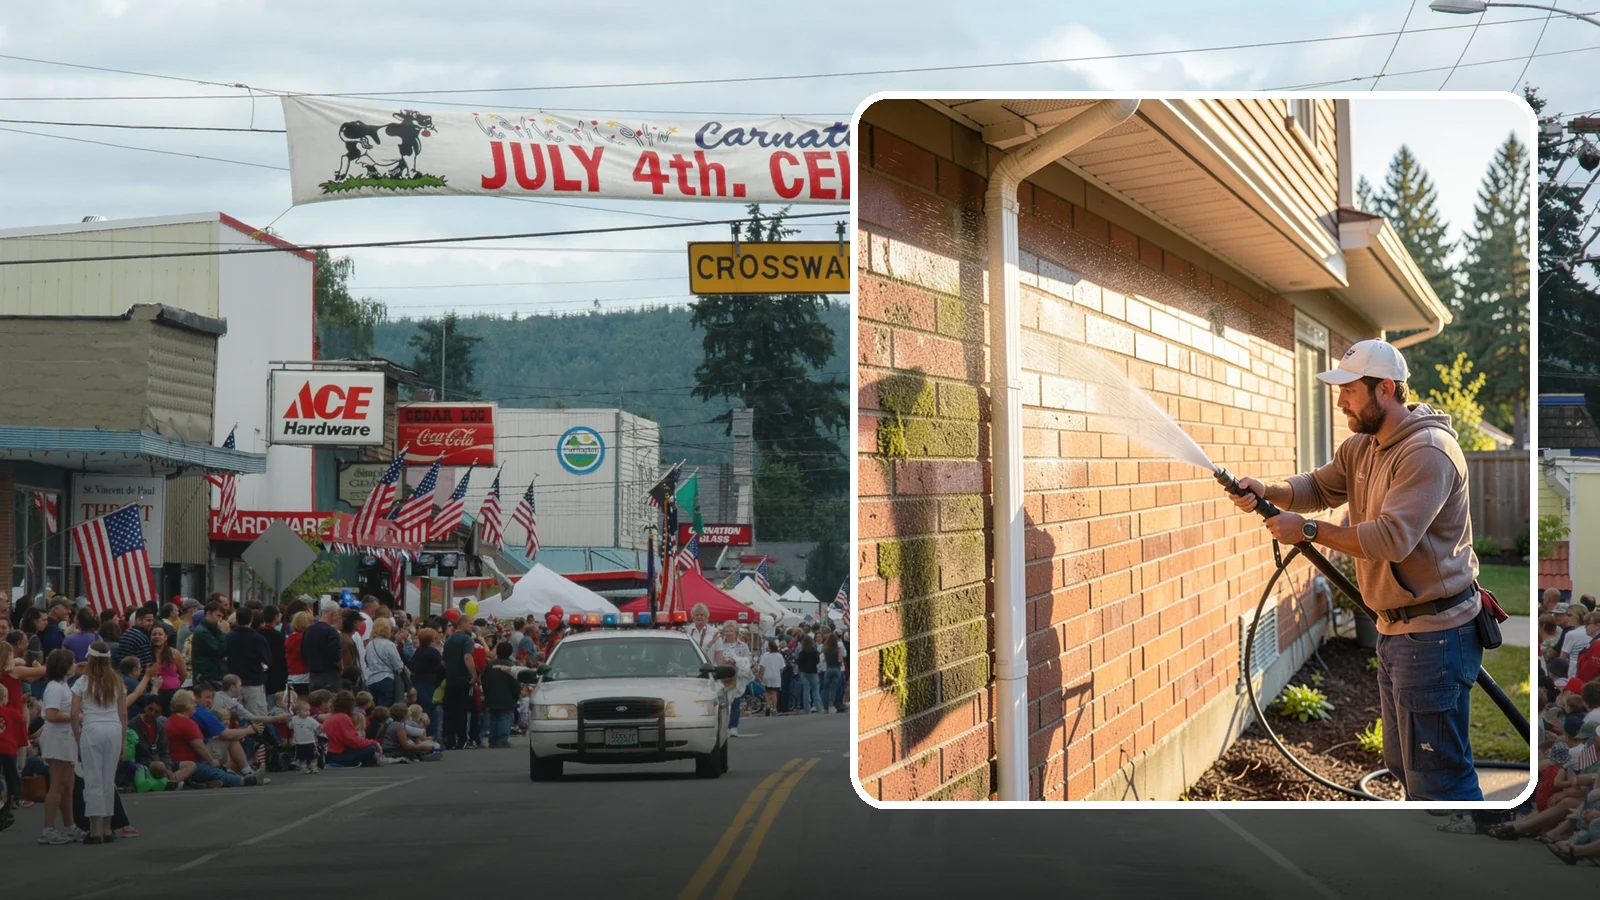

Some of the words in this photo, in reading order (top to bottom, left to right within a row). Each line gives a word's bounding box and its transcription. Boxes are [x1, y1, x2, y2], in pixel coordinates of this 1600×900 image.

[481, 141, 604, 193] JULY
[632, 150, 746, 198] 4th.
[696, 254, 850, 280] CROSSWA
[283, 380, 373, 420] ACE
[405, 409, 452, 422] CEDAR
[283, 421, 370, 436] Hardware
[353, 467, 386, 479] Simpl
[96, 484, 124, 495] Vincent
[126, 485, 136, 495] de
[138, 486, 155, 495] Paul
[80, 503, 154, 522] THT
[688, 526, 741, 535] CRNATION
[699, 535, 730, 543] GLASS
